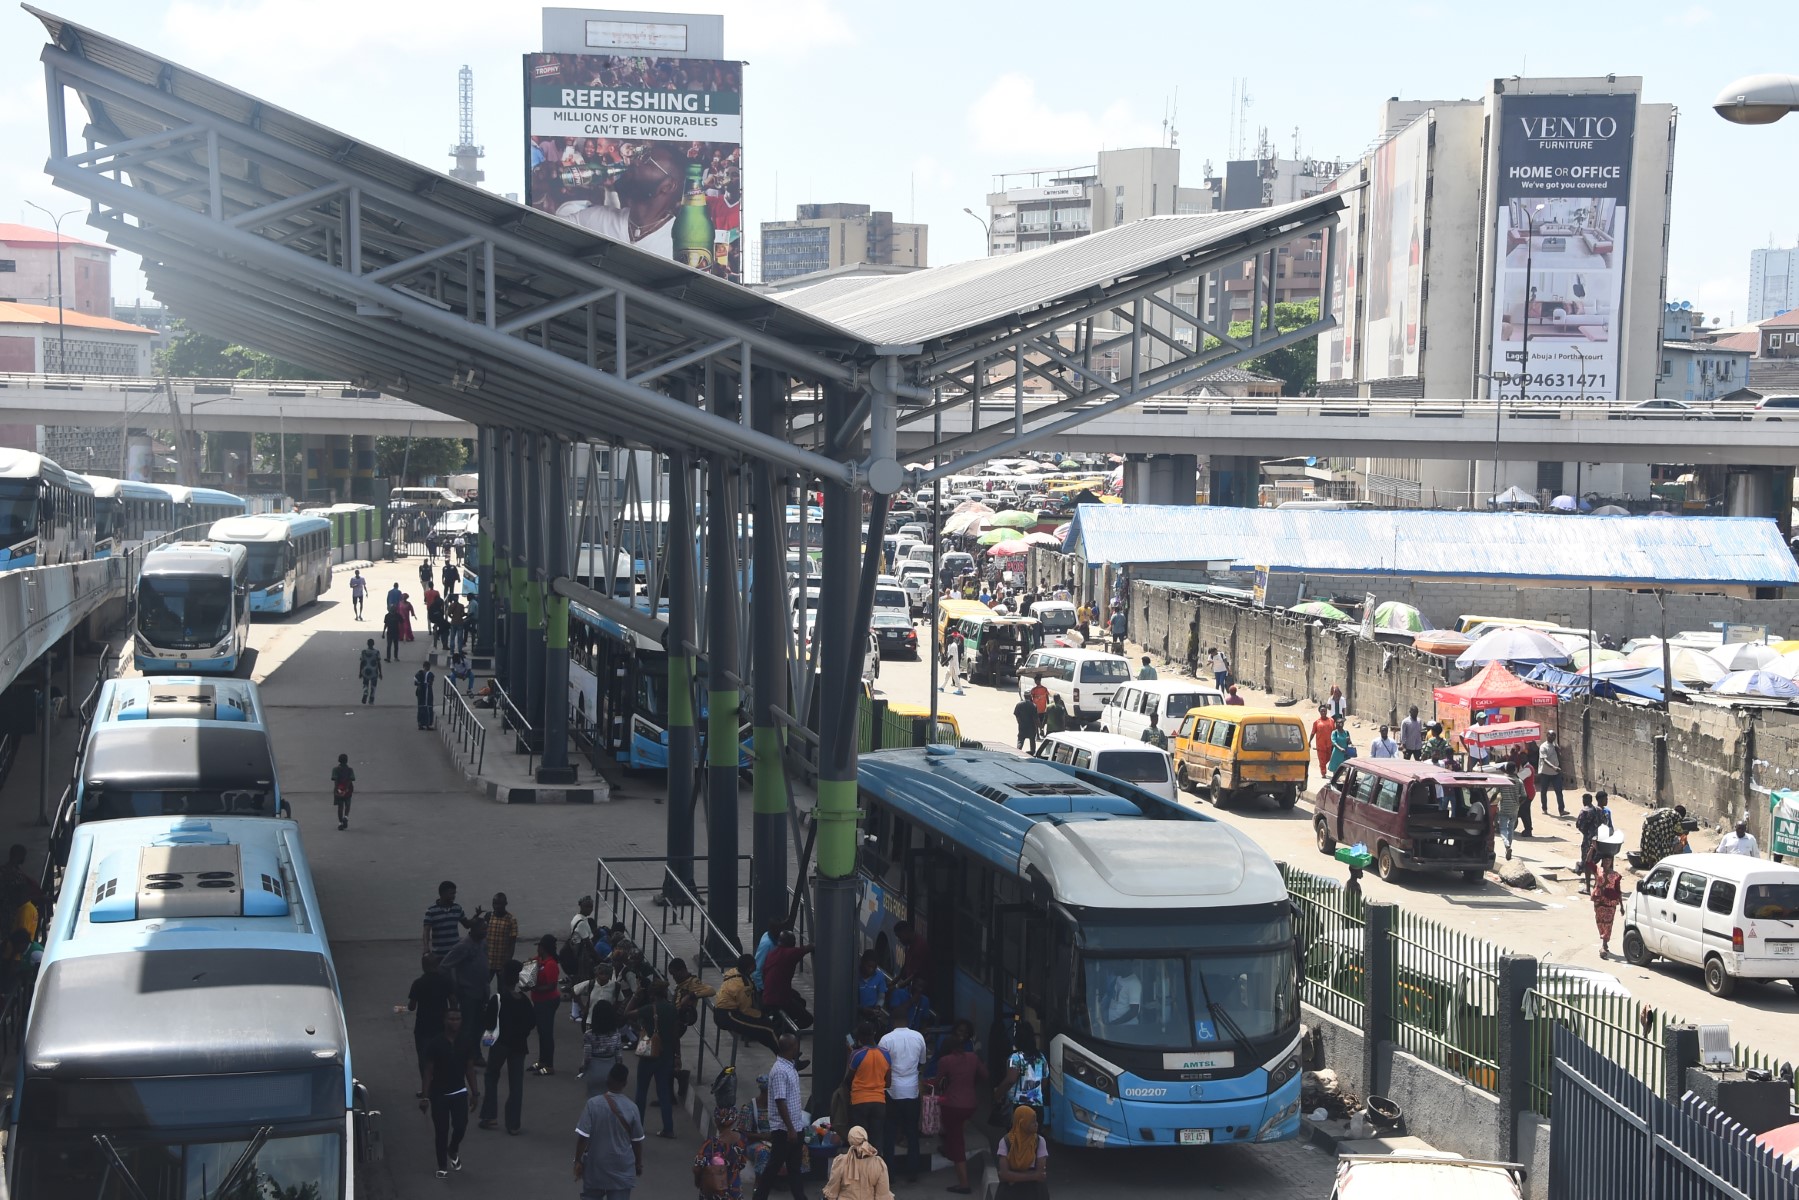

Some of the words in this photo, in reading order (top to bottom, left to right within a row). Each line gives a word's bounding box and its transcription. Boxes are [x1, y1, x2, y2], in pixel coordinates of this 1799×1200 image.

[535, 65, 559, 75] TROPHY
[561, 88, 698, 111] REFRESHING
[553, 111, 608, 123] MILLIONS
[611, 113, 627, 125] OF
[630, 114, 718, 127] HONOURABLES
[584, 124, 619, 135] CAN'T
[622, 126, 637, 136] BE
[640, 126, 688, 138] WRONG.
[1520, 117, 1617, 138] VENTO
[1539, 141, 1593, 149] FURNITURE
[1509, 166, 1553, 179] HOME
[1554, 167, 1569, 177] OR
[1570, 166, 1620, 178] OFFICE
[1521, 181, 1544, 189] We've
[1545, 181, 1559, 190] got
[1576, 181, 1608, 189] covered
[1507, 352, 1527, 361] Lago
[1531, 352, 1553, 360] Abuja
[1006, 561, 1024, 571] POS
[1125, 1088, 1167, 1097] 0102207
